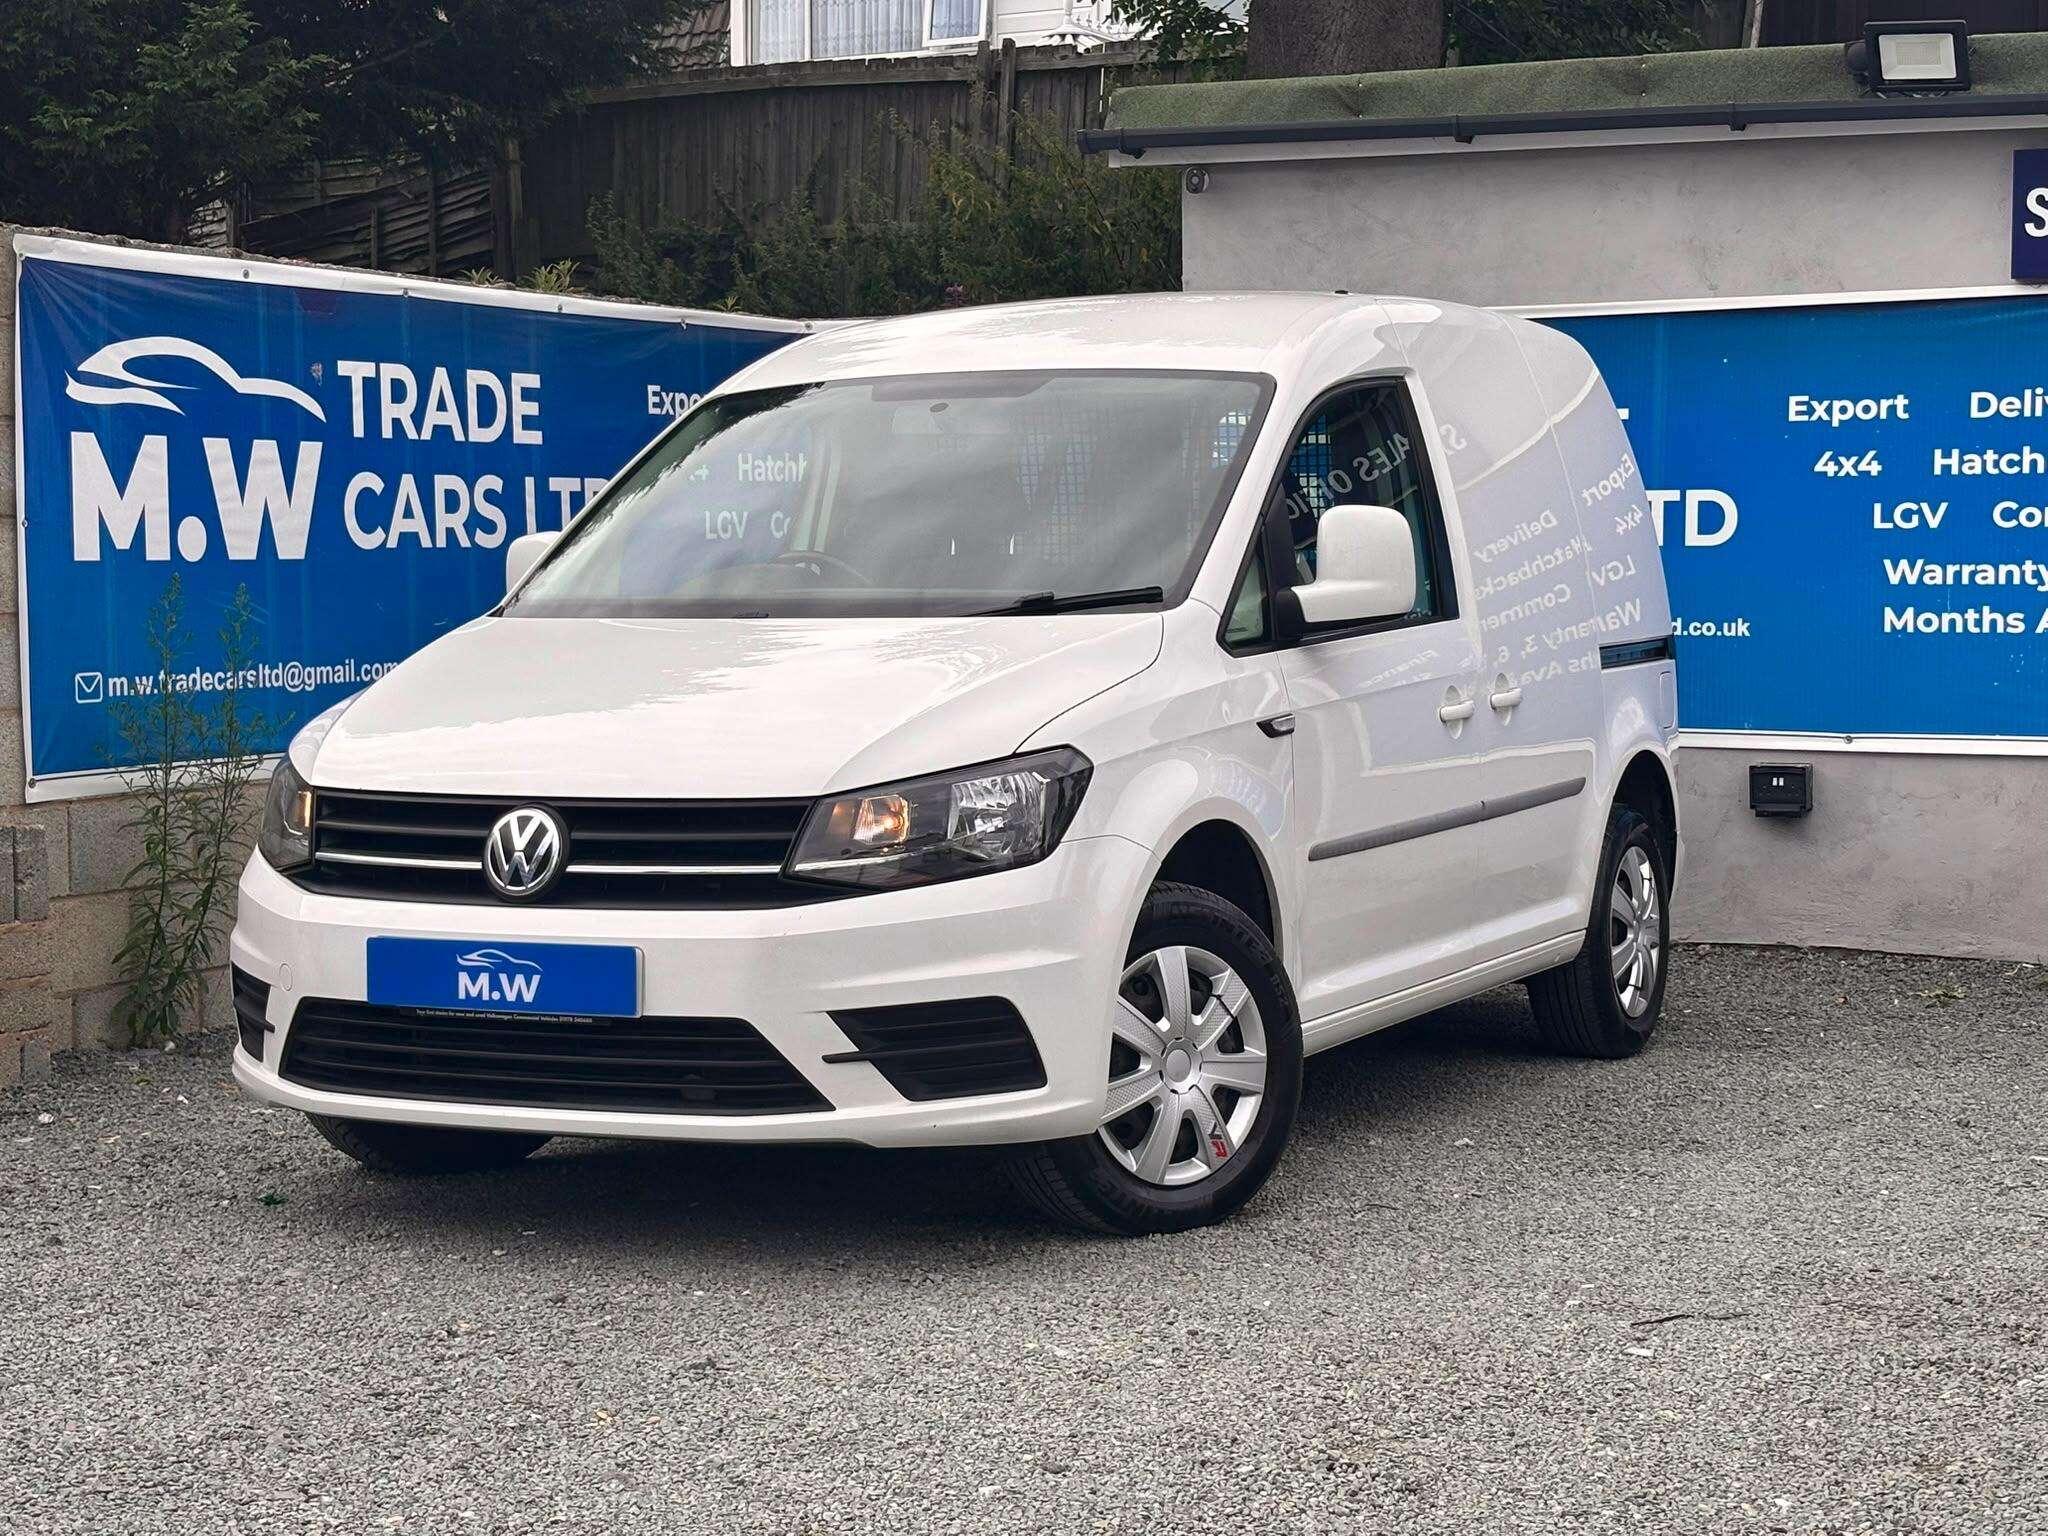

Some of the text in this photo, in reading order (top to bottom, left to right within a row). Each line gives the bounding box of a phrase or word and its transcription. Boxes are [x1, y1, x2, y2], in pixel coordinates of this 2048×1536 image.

[337, 360, 543, 445] TRADE
[647, 384, 706, 418] Expo
[1788, 387, 2048, 428] Export Deli
[1814, 446, 2045, 477] 4x4 Hatch
[70, 431, 323, 562] M.W
[344, 471, 507, 550] CARS
[705, 511, 748, 540] LGV
[1645, 489, 1738, 546] TD
[1873, 500, 2048, 529] LGV Co
[1884, 605, 2026, 633] Months
[458, 971, 541, 1003] M.W
